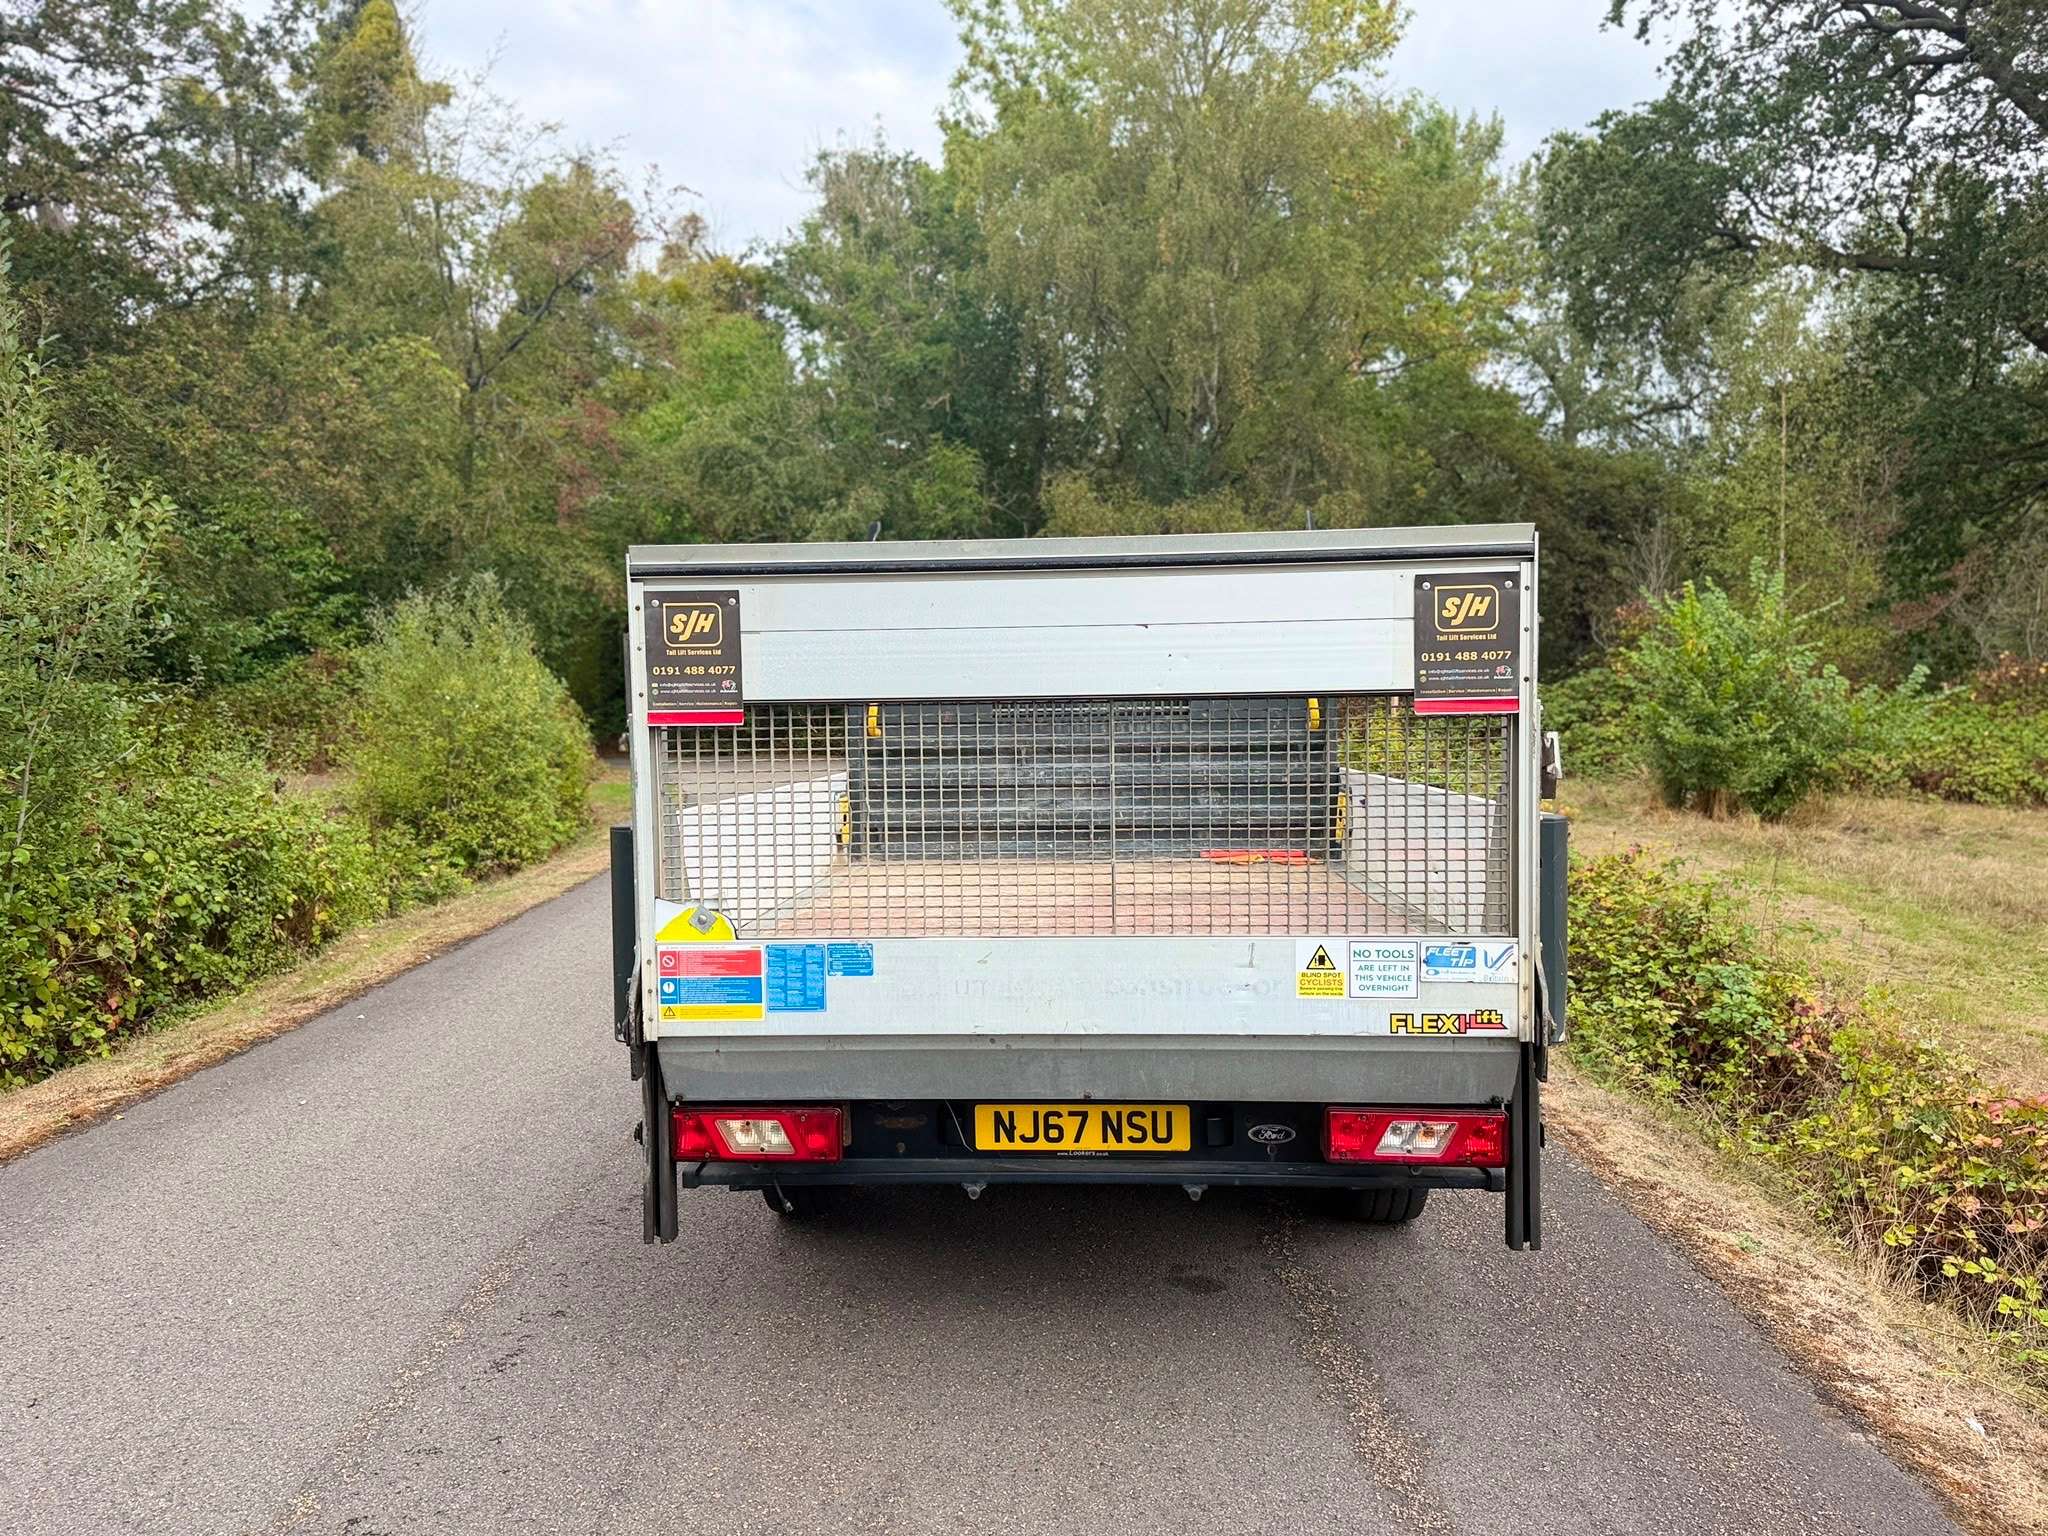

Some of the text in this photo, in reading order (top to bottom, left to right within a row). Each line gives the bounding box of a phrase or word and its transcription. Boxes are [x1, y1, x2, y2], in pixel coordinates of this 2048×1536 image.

[1441, 593, 1492, 626] SJH
[670, 609, 715, 642] SJH
[1459, 633, 1487, 641] Services
[1421, 650, 1512, 662] 0191 488 4077
[652, 665, 736, 675] 0191 488 4077
[1353, 949, 1414, 959] NO TOOLS
[1358, 984, 1409, 992] OVERNIGHT
[993, 1110, 1173, 1144] NJ67 NSU
[1258, 1127, 1286, 1140] Ford
